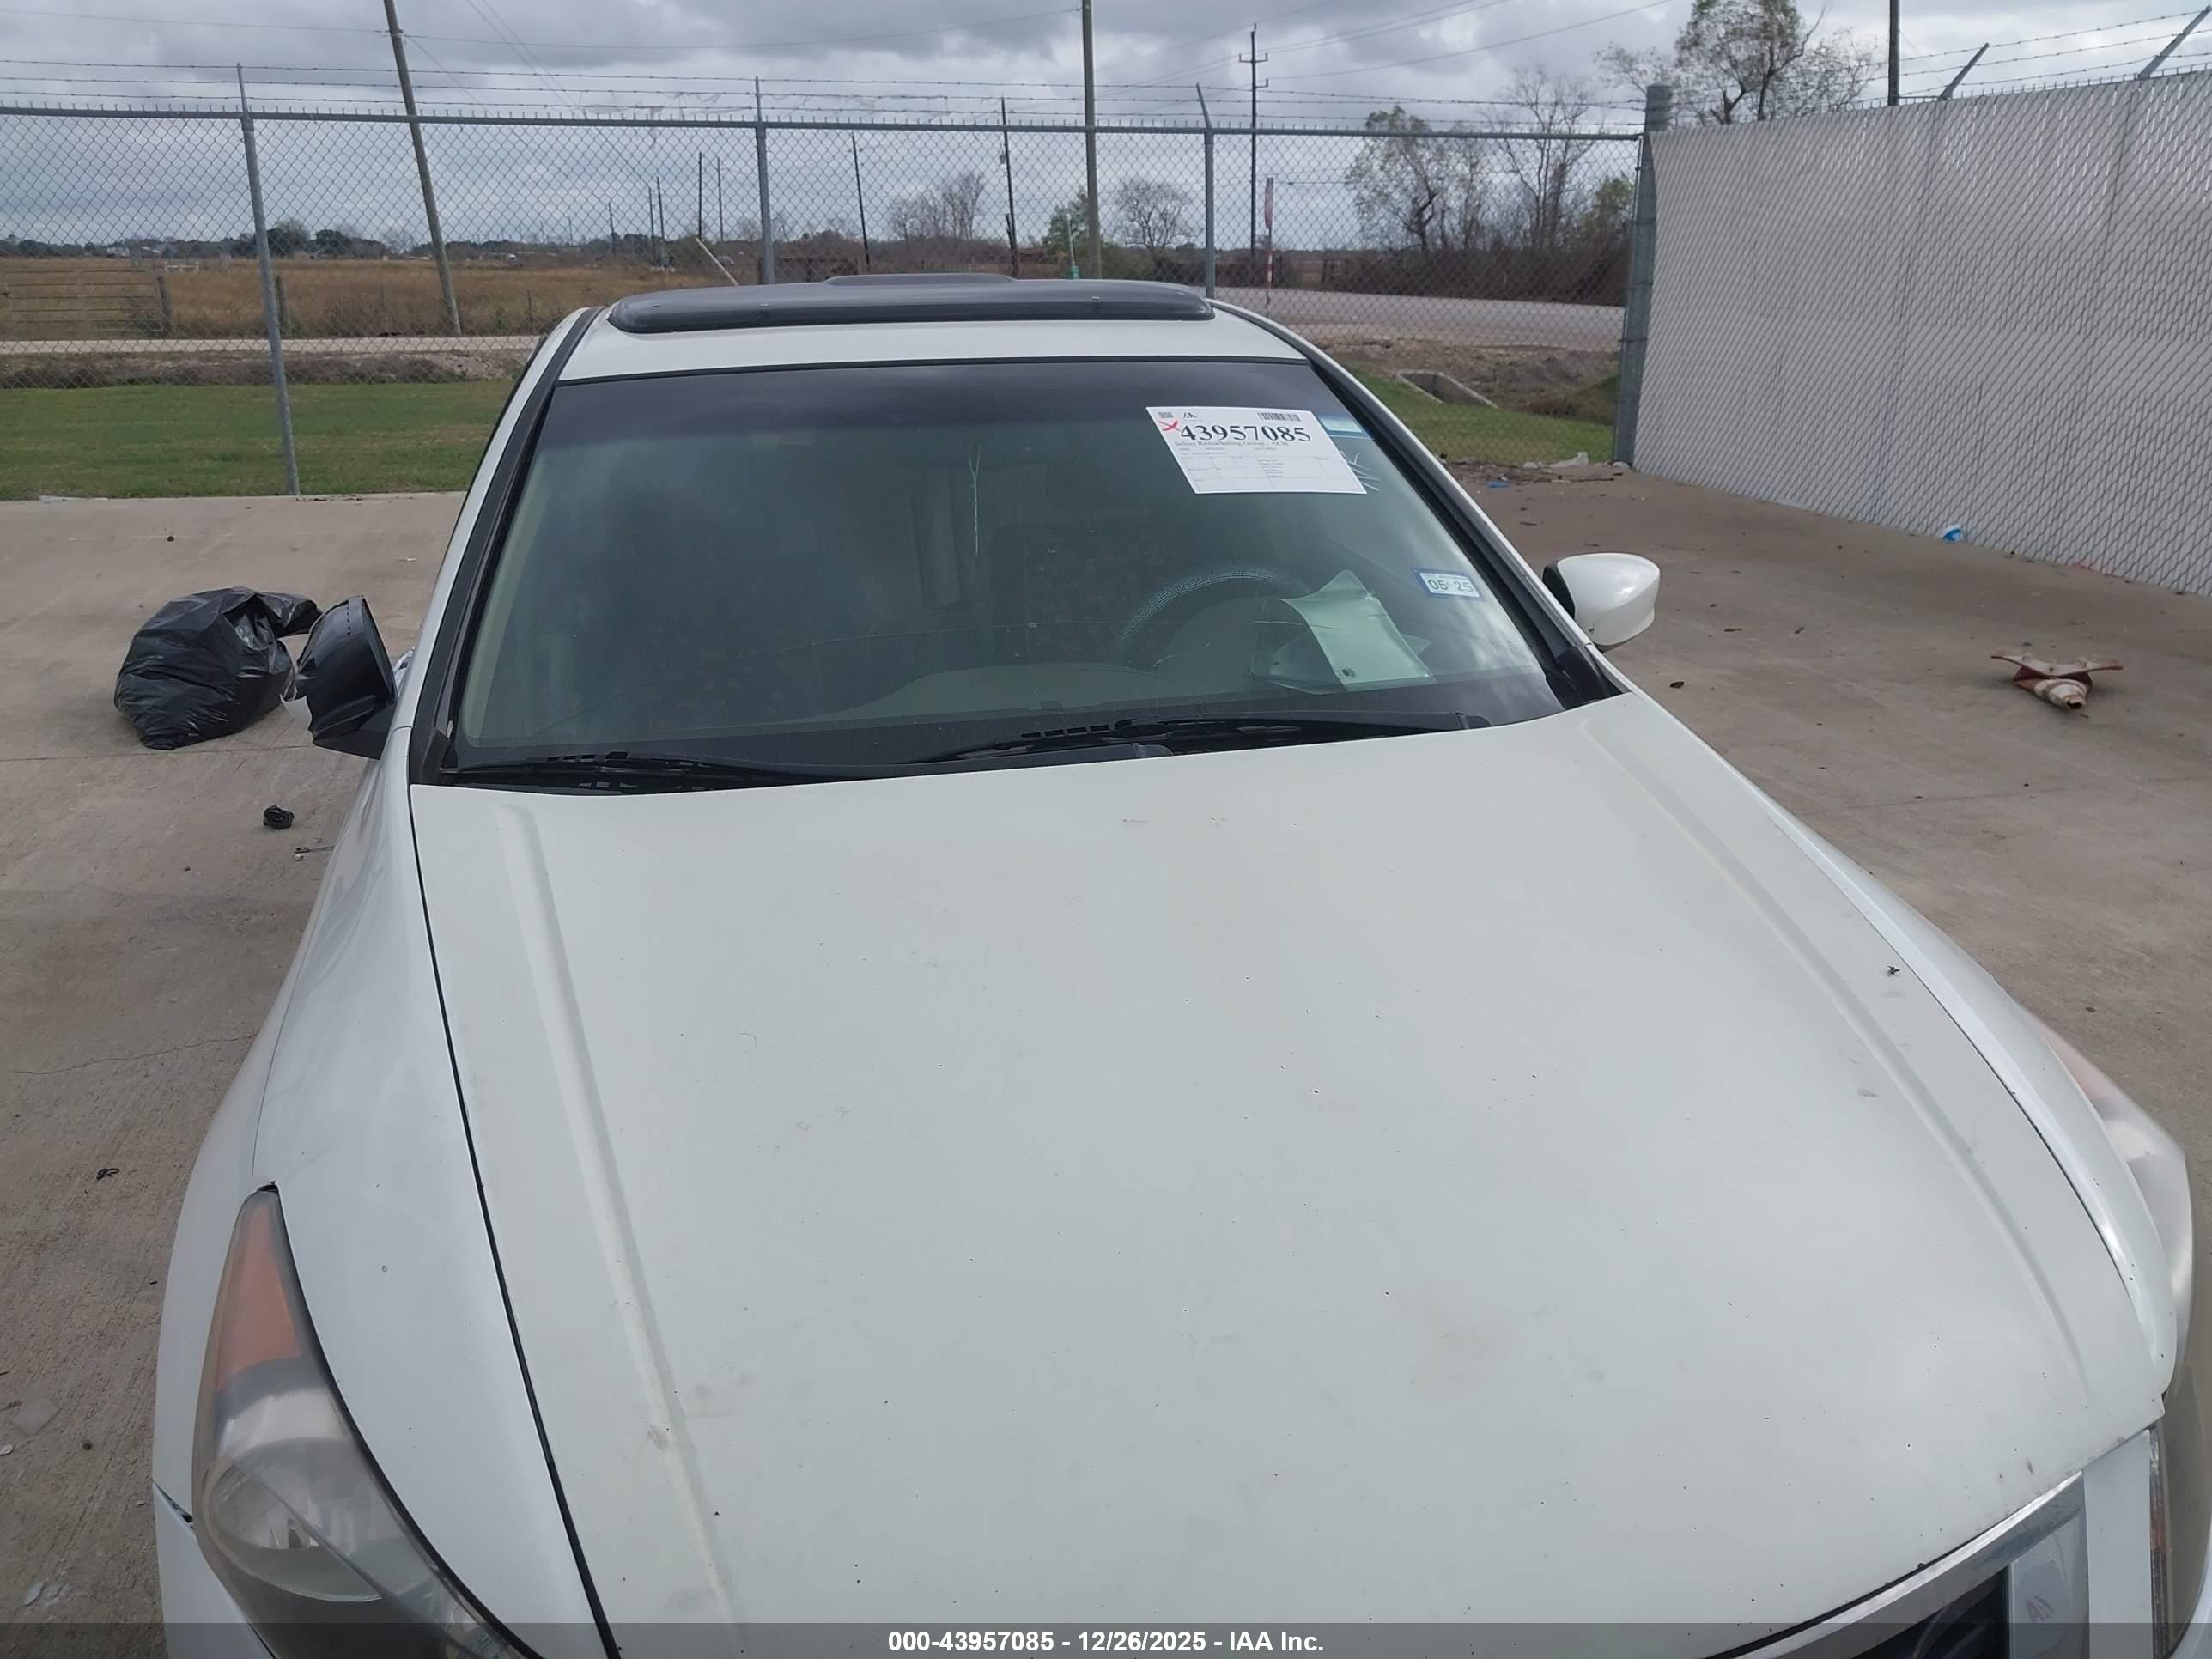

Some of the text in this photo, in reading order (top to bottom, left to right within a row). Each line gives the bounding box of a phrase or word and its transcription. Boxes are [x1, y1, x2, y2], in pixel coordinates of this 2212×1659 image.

[1181, 425, 1311, 441] 43957085
[1428, 580, 1474, 592] 05 25
